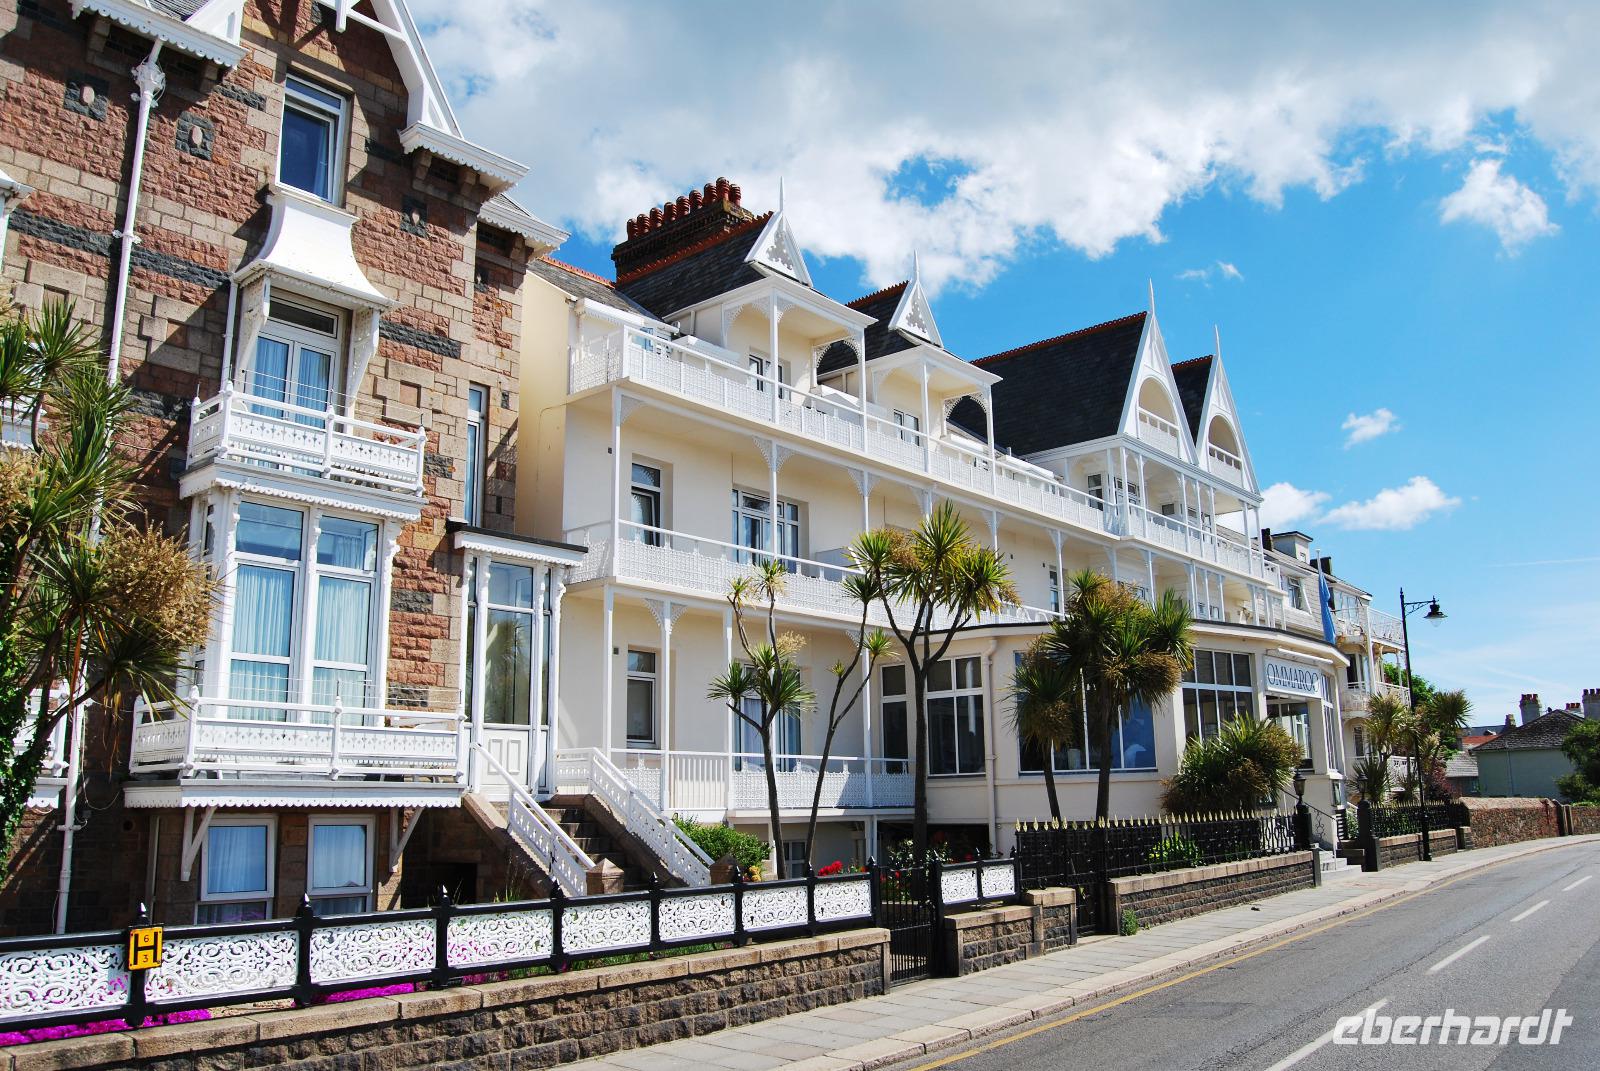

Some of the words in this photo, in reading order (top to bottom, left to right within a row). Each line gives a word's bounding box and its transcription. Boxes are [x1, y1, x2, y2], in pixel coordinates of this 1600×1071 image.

[1267, 663, 1319, 692] OMMAROO
[133, 932, 158, 965] H
[143, 935, 150, 943] 6
[142, 954, 149, 963] 3
